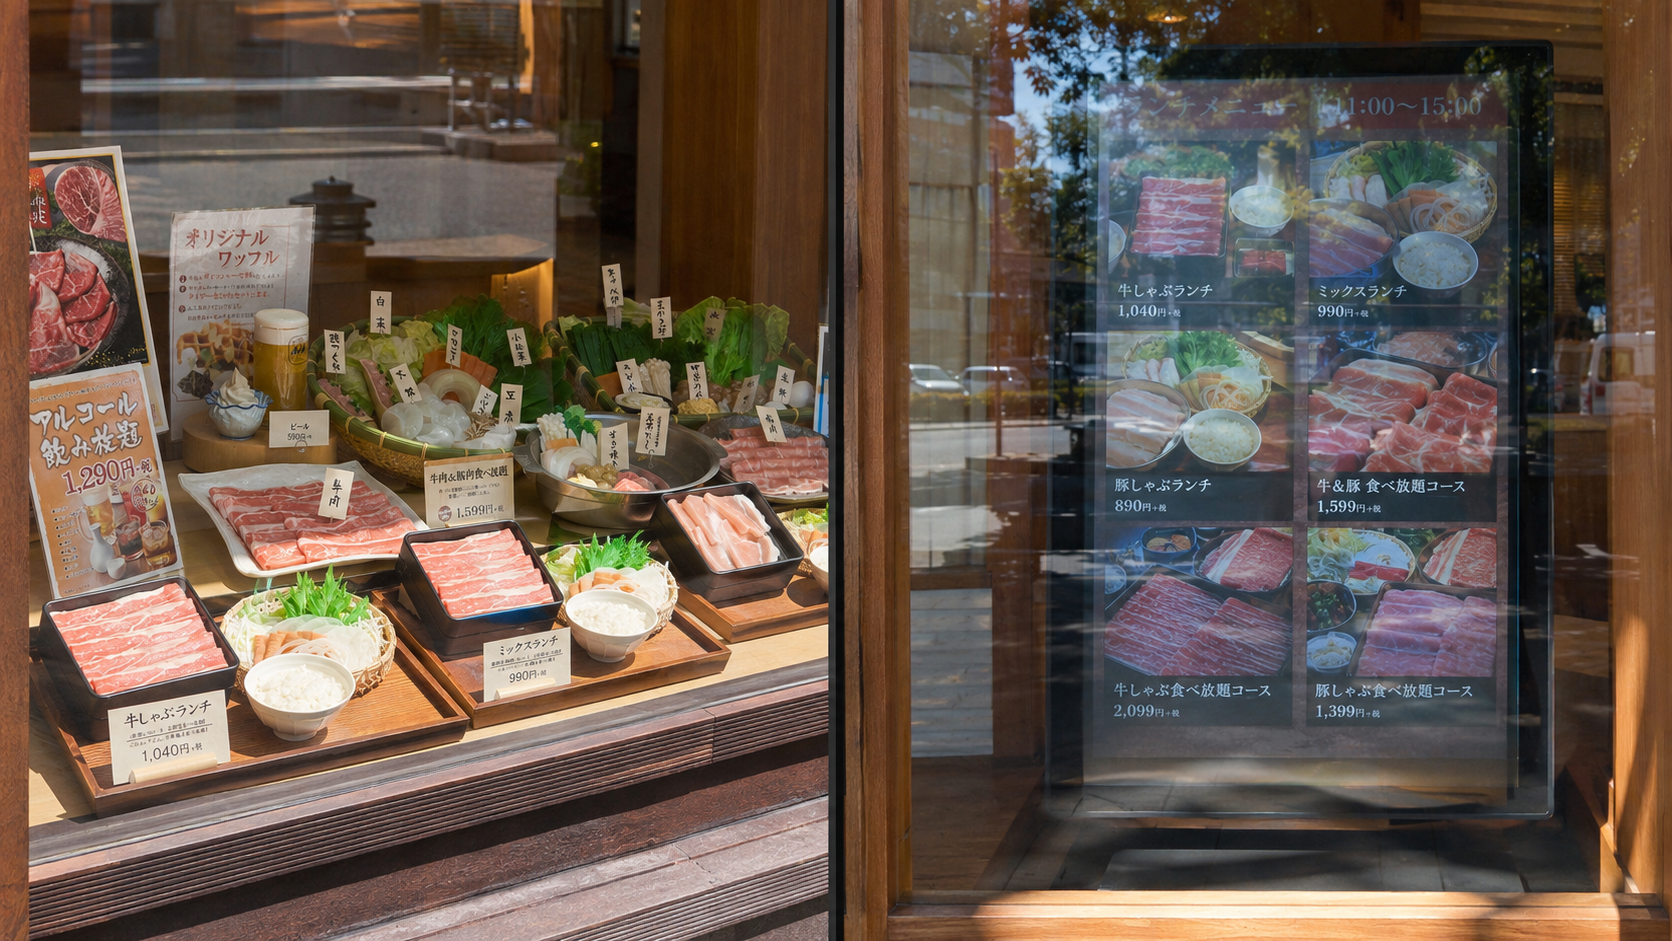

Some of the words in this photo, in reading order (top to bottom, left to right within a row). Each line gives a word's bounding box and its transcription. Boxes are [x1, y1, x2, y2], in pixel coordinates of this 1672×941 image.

[185, 228, 269, 249] オリジナル
[218, 250, 280, 268] ワッフル
[1117, 283, 1213, 298] 牛しゃぶランチ
[1318, 284, 1407, 298] ミックスランチ
[29, 390, 138, 437] アルコール
[290, 423, 310, 431] ビール
[40, 418, 143, 469] 飲み放題
[1114, 477, 1212, 493] 豚しゃぶランチ
[1316, 478, 1361, 494] 牛&豚
[1365, 477, 1466, 494] 食べ放題コース
[499, 635, 558, 656] ミックスランチ
[1113, 682, 1272, 698] 牛しゃぶ食べ放題コース
[1314, 683, 1473, 699] 豚しゃぶ食べ放題コース
[124, 699, 212, 729] 牛しゃぶランチ
